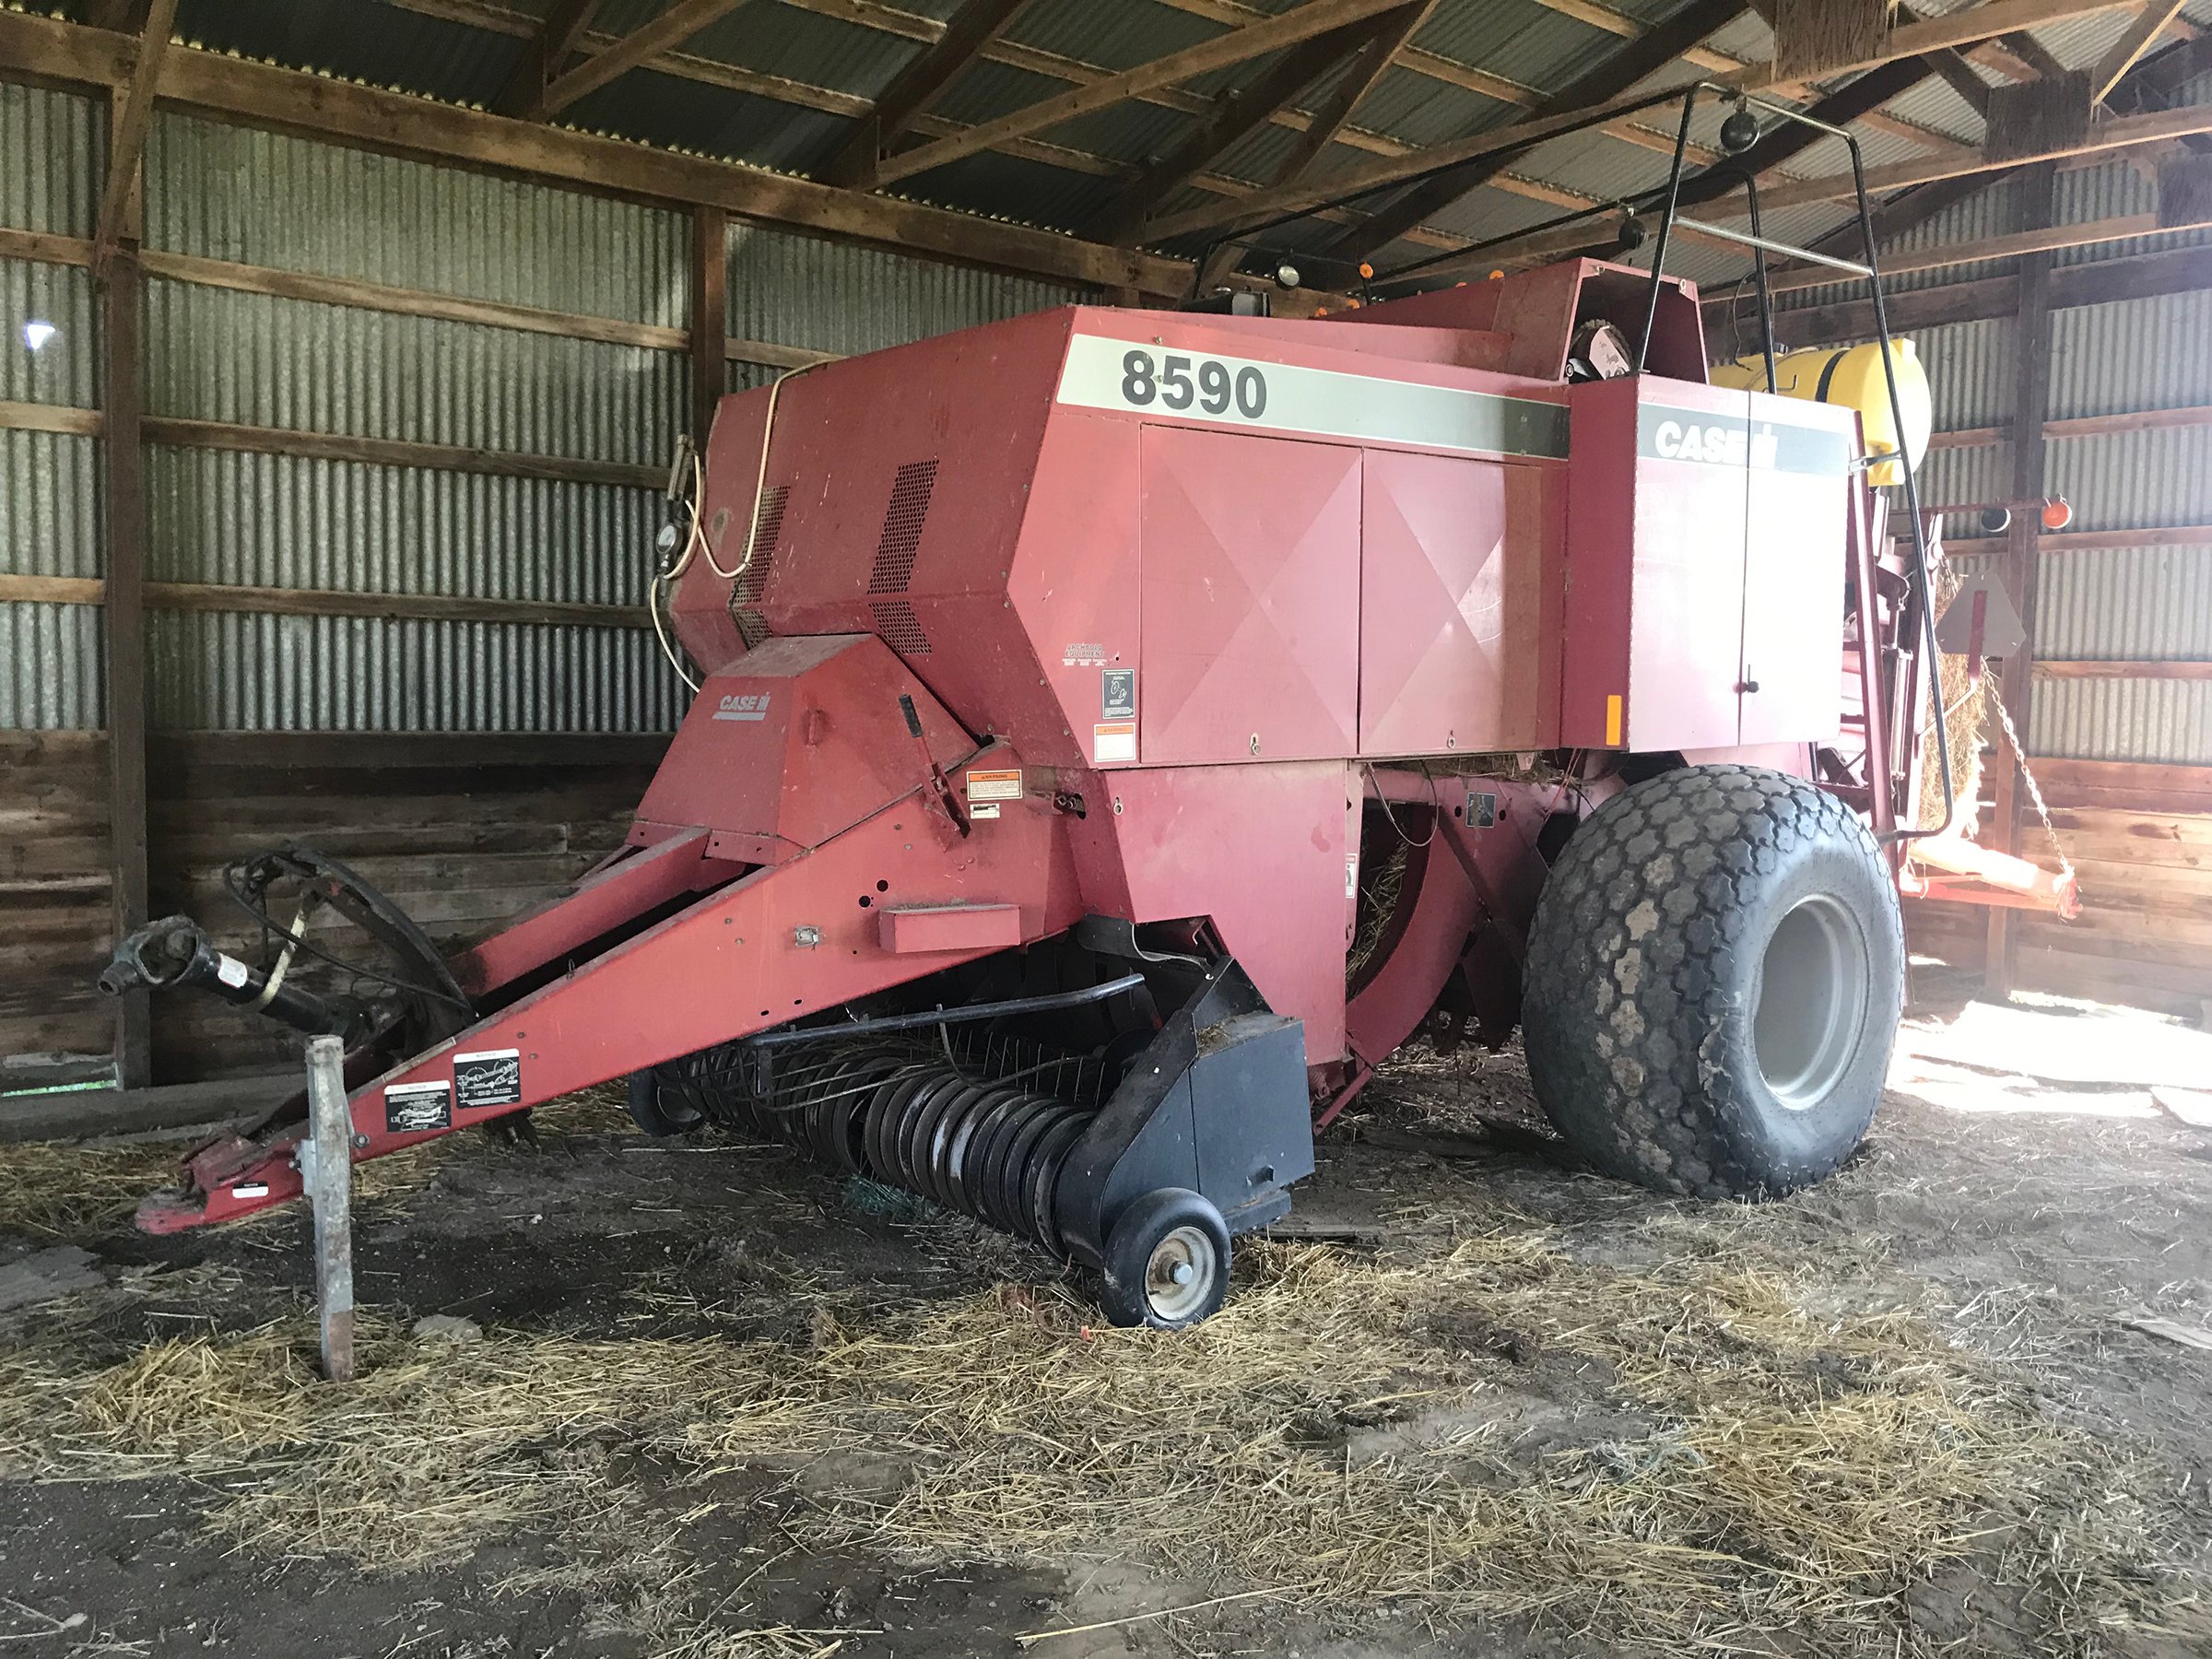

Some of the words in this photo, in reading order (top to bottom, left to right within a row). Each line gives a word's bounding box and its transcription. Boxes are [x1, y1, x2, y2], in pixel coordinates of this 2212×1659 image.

[1122, 350, 1267, 418] 8590
[1655, 420, 1747, 465] CASE
[720, 695, 757, 711] CASE
